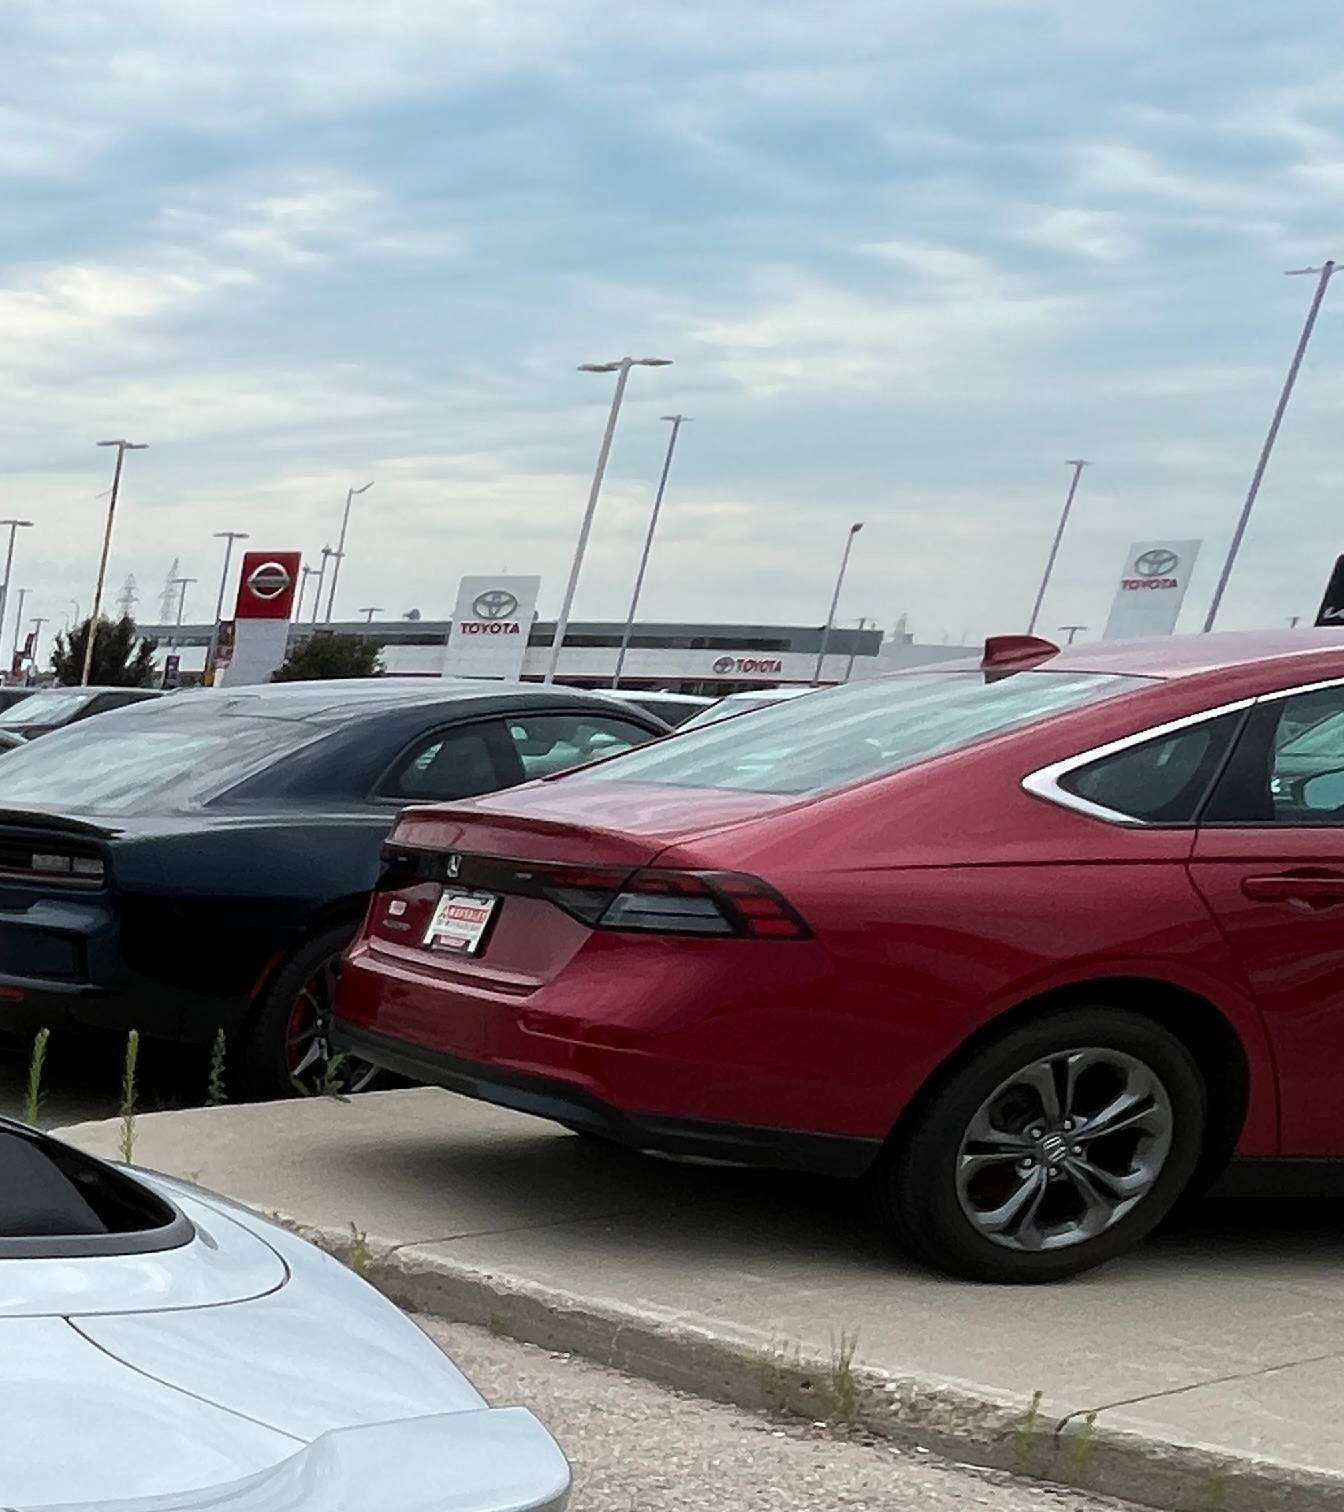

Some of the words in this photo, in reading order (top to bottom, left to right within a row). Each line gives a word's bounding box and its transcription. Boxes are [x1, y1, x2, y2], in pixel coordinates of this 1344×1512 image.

[1120, 578, 1178, 590] TOYOTA
[461, 622, 520, 634] TOYOTA
[736, 659, 782, 673] TOYOTA
